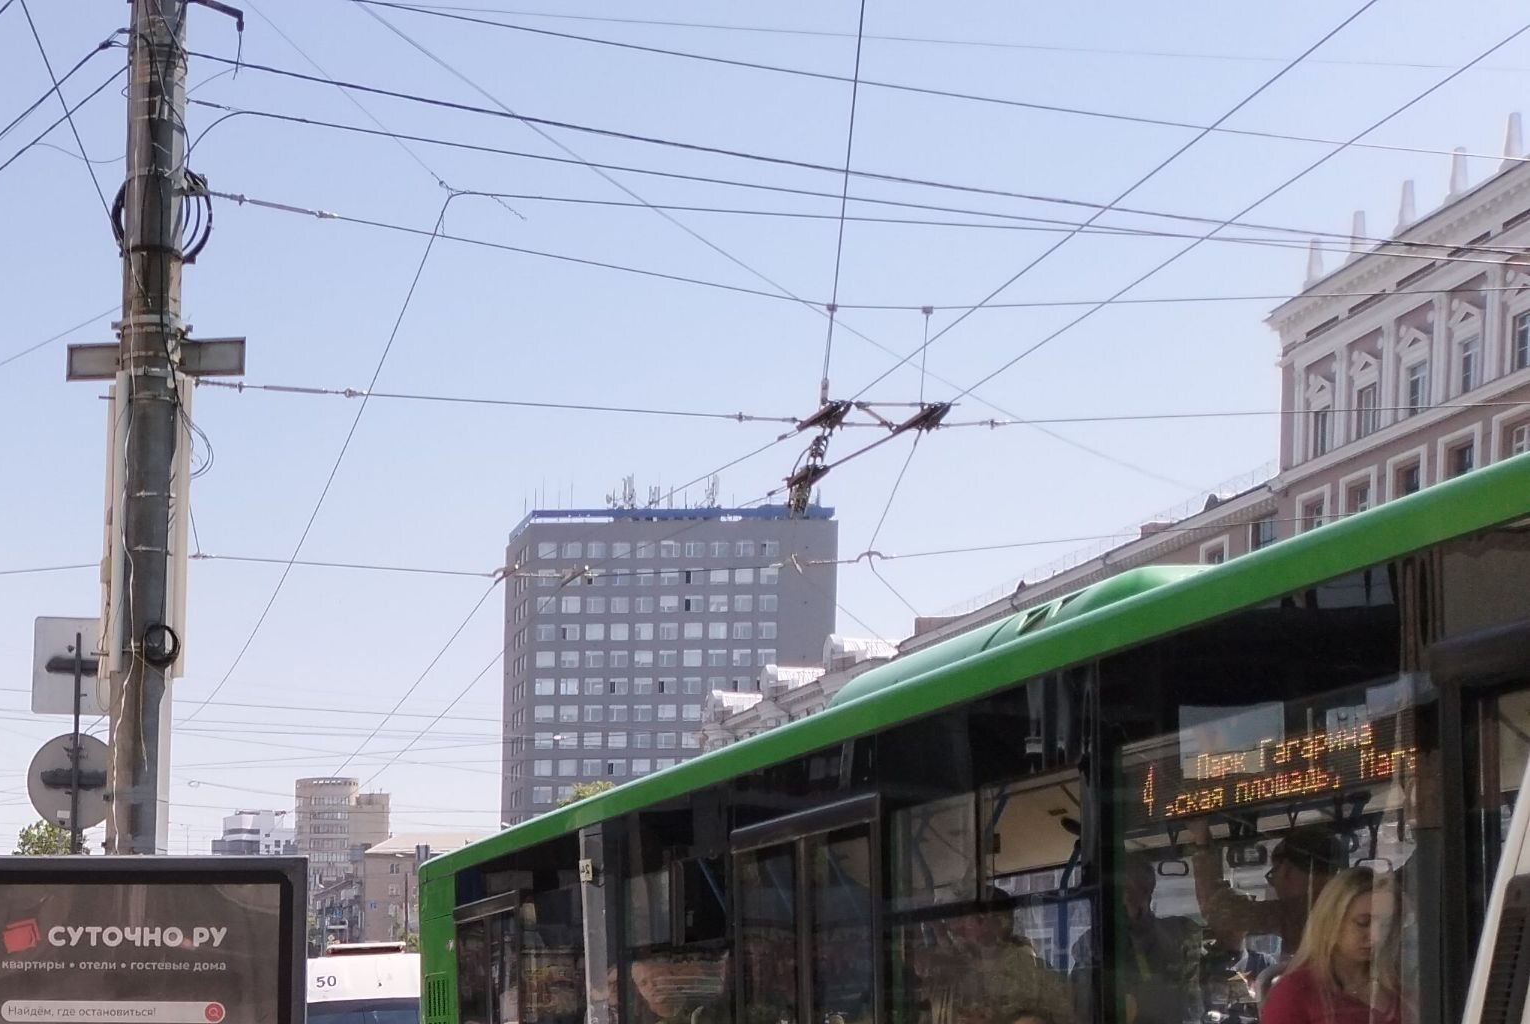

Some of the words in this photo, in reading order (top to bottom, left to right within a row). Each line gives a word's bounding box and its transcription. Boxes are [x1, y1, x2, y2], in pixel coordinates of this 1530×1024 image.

[1197, 752, 1247, 781] Парк
[1260, 723, 1374, 769] Гагарина
[48, 926, 228, 949] СУТОЧНО.РУ
[2, 960, 65, 972] квартиры
[79, 961, 117, 970] отели
[130, 961, 190, 971] гостевые
[193, 961, 227, 971] дома
[316, 975, 337, 989] 50
[8, 1007, 54, 1018] Найдём,
[57, 1008, 76, 1018] где
[78, 1007, 157, 1017] остановиться!
